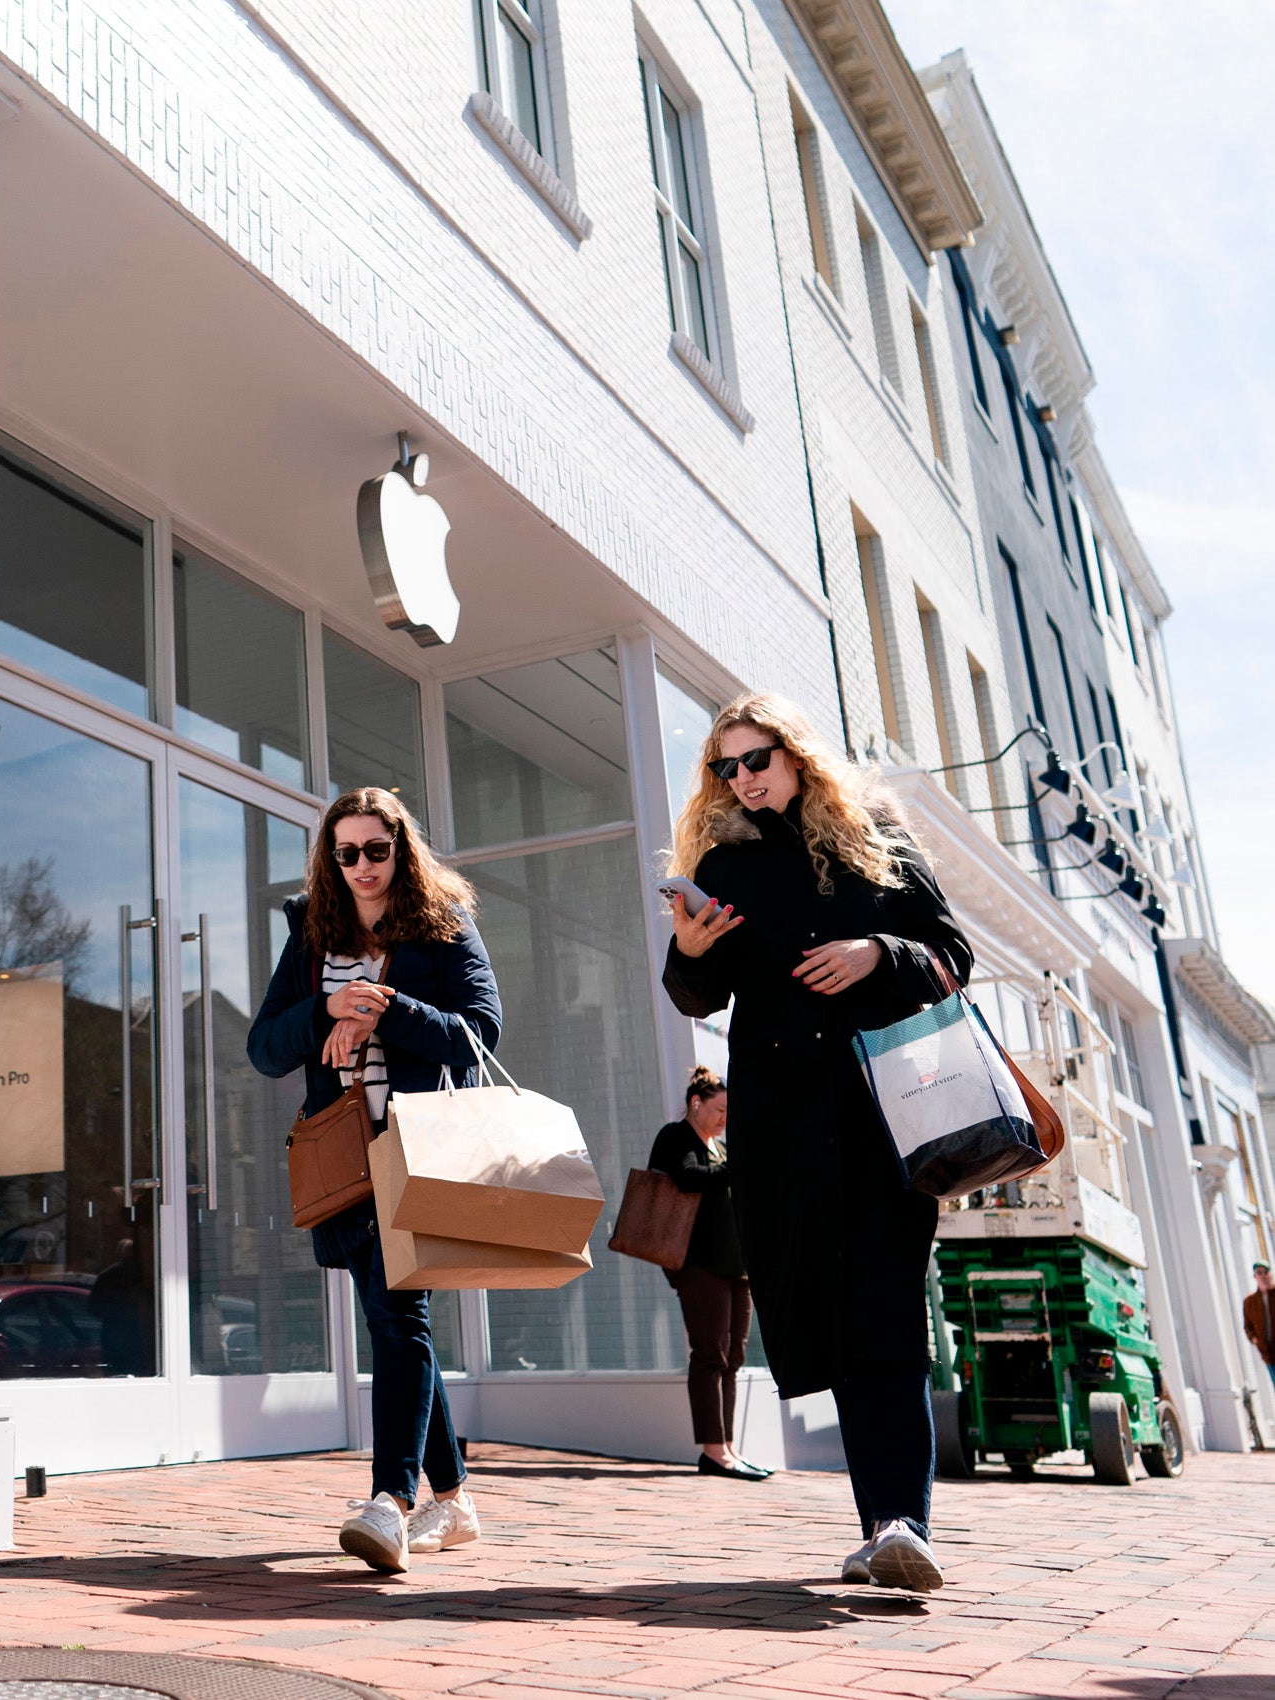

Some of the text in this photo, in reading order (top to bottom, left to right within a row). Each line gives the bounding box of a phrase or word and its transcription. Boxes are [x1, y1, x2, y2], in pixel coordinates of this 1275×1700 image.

[8, 1071, 30, 1086] Pro
[901, 1072, 963, 1100] vineyard vines
